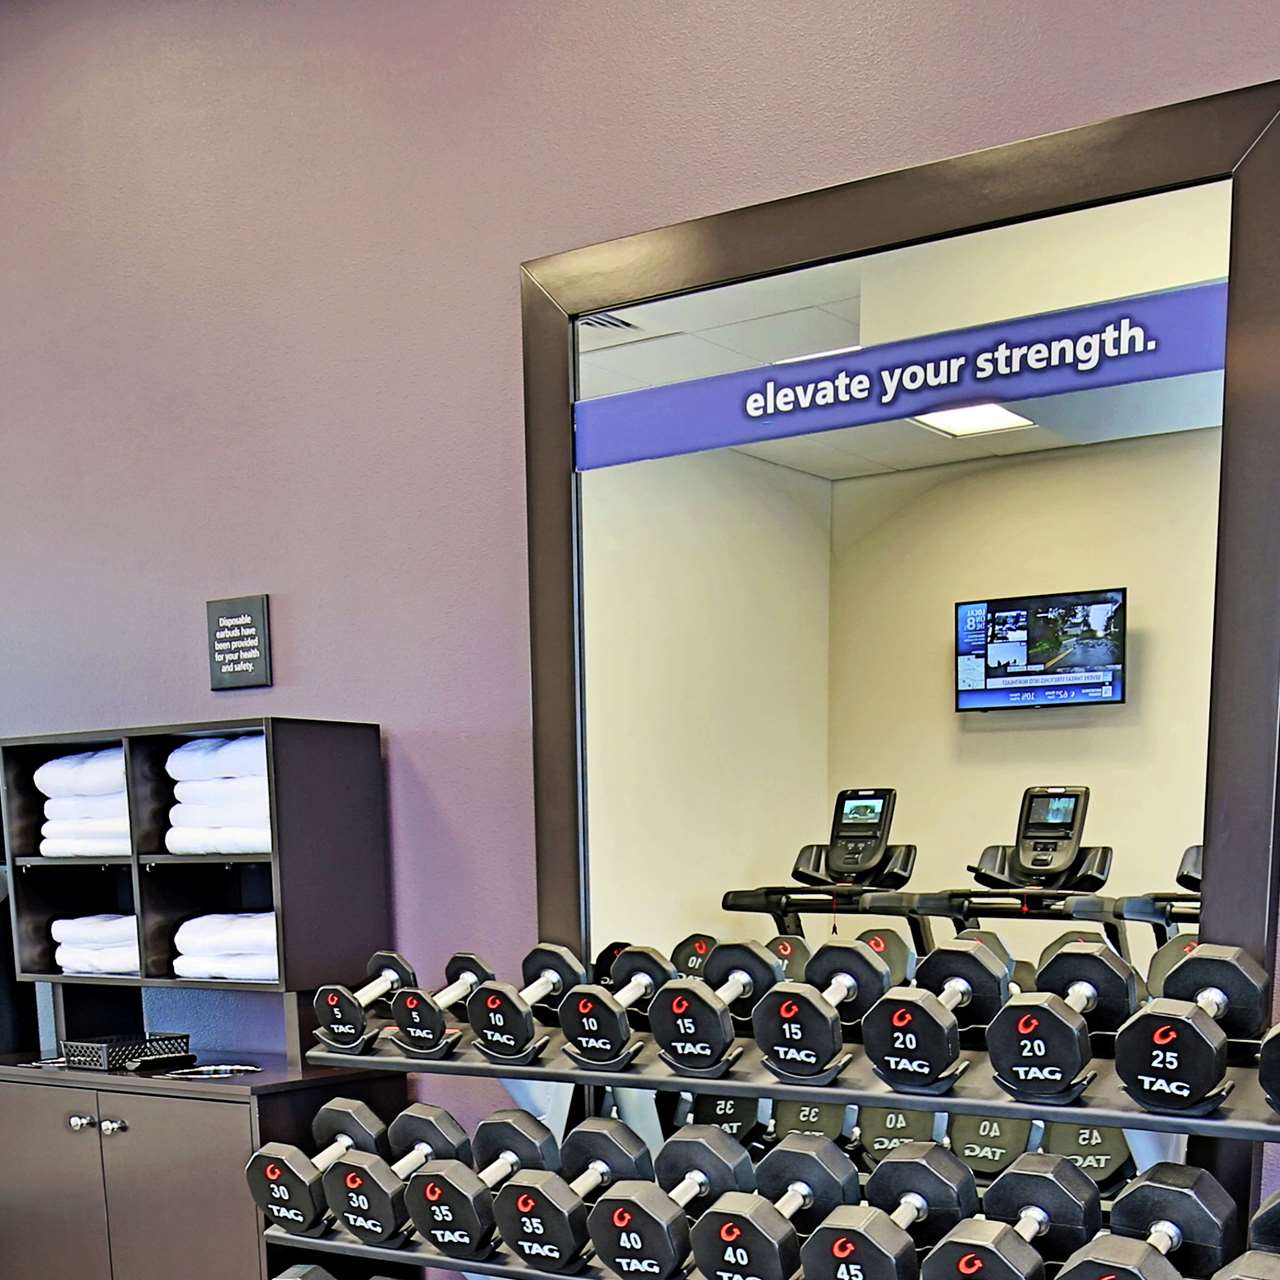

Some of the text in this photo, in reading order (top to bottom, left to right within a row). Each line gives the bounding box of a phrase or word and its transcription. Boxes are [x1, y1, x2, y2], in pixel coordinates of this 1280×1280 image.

[746, 318, 1156, 417] elevate your strength.
[219, 614, 252, 627] Disposable
[216, 626, 256, 639] earbuds have
[215, 637, 259, 651] been provided
[215, 648, 260, 663] for your health
[221, 661, 254, 673] and safety.
[333, 1007, 342, 1019] 5
[411, 1011, 420, 1023] 5
[488, 1012, 504, 1026] 10
[330, 1024, 356, 1034] TAG
[581, 1017, 598, 1031] 10
[677, 1019, 694, 1033] 15
[783, 1023, 801, 1039] 15
[406, 1027, 434, 1039] TAG
[484, 1030, 514, 1045] TAG
[894, 1032, 916, 1049] 20
[577, 1036, 612, 1050] TAG
[671, 1042, 712, 1056] TAG
[1021, 1040, 1045, 1056] 20
[774, 1047, 816, 1063] TAG
[1152, 1050, 1177, 1069] 25
[885, 1057, 929, 1073] TAG
[1012, 1066, 1062, 1081] TAG
[1138, 1076, 1189, 1096] TAG
[270, 1184, 288, 1199] 30
[349, 1193, 368, 1209] 30
[268, 1205, 303, 1222] TAG
[431, 1206, 452, 1221] 35
[344, 1213, 382, 1233] TAG
[522, 1217, 543, 1234] 35
[430, 1230, 470, 1244] TAG
[620, 1233, 641, 1249] 40
[518, 1241, 559, 1258] TAG
[724, 1247, 748, 1265] 40
[616, 1259, 659, 1273] TAG
